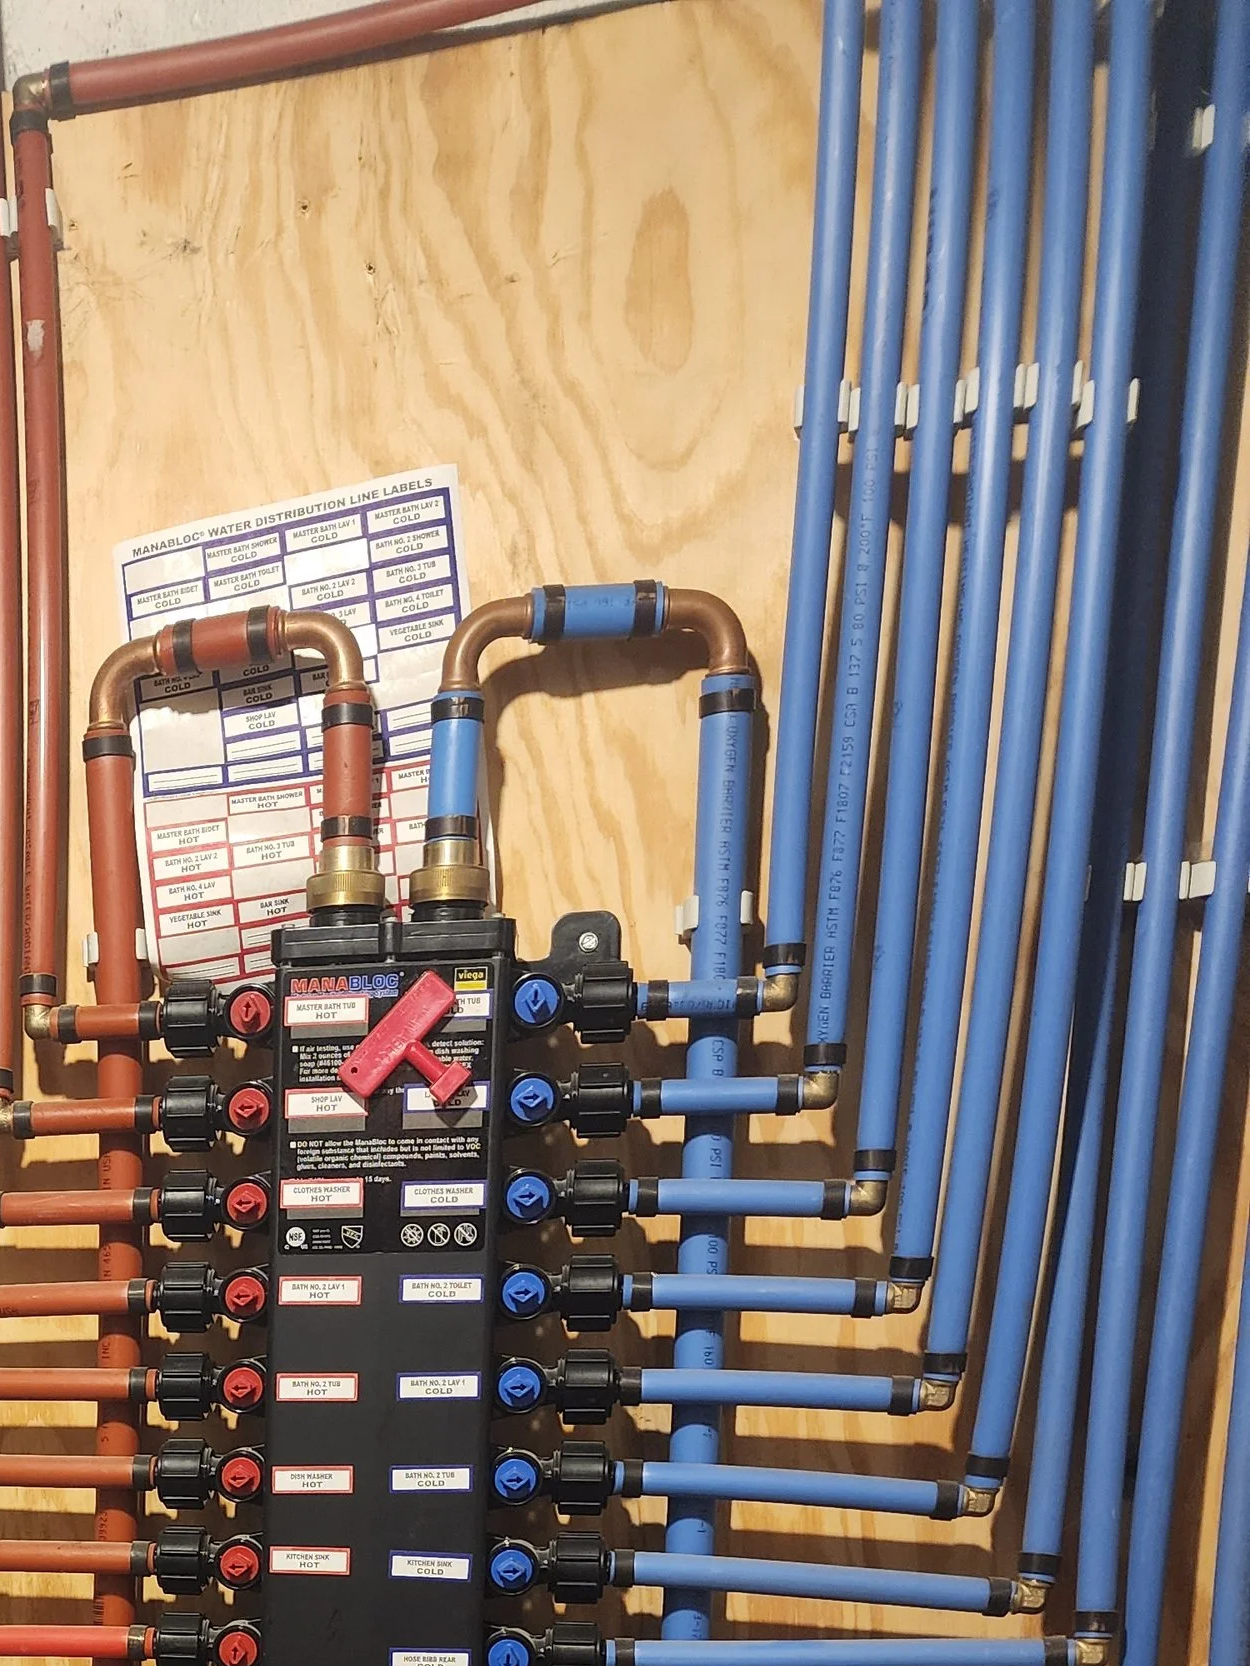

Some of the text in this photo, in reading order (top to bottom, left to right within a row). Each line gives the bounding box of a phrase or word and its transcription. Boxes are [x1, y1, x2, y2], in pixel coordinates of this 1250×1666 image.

[863, 479, 876, 502] 100
[208, 521, 250, 538] WATER
[255, 498, 345, 527] DISTRIBUTION
[350, 490, 379, 505] LINE
[383, 478, 432, 496] LABELS
[393, 513, 420, 525] COLD
[311, 532, 338, 543] COLD
[207, 537, 277, 559] MASTER BATH SHOWER
[396, 542, 423, 554] COLD
[231, 551, 258, 562] COLD
[398, 572, 426, 583] COLD
[234, 579, 260, 591] COLD
[317, 590, 344, 601] COLD
[855, 583, 868, 605] PSI
[155, 598, 181, 608] COLD
[402, 602, 429, 613] COLD
[390, 619, 444, 636] VEGETABLE SINK
[853, 614, 864, 630] 80
[404, 631, 432, 642] COLD
[243, 665, 269, 676] COLD
[848, 656, 861, 676] 137
[165, 682, 190, 693] COLD
[246, 692, 273, 704] COLD
[246, 712, 276, 722] SHOP LAV
[844, 703, 858, 728] CSA
[249, 720, 275, 729] COLD
[840, 736, 855, 776] F2159
[836, 783, 850, 823] F1807
[178, 837, 199, 845] HOT
[714, 725, 738, 947] OXYGEN BARRIER ASTM F876 F877
[832, 830, 846, 862] F877
[261, 852, 282, 860] HOT
[181, 864, 202, 872] HOT
[829, 870, 842, 901] F876
[184, 892, 204, 901] HOT
[260, 898, 289, 909] BAR SINK
[170, 909, 221, 923] VEGETABLE SINK
[267, 907, 287, 915] HOT
[187, 921, 208, 929] HOT
[825, 907, 839, 938] ASTM
[458, 970, 484, 980] viega
[820, 946, 836, 999] BARRIER
[311, 1095, 342, 1104] SHOP LAV
[316, 1104, 336, 1112] HOT
[710, 1149, 722, 1168] PSI
[430, 1196, 459, 1204] COLD
[428, 1290, 456, 1298] COLD
